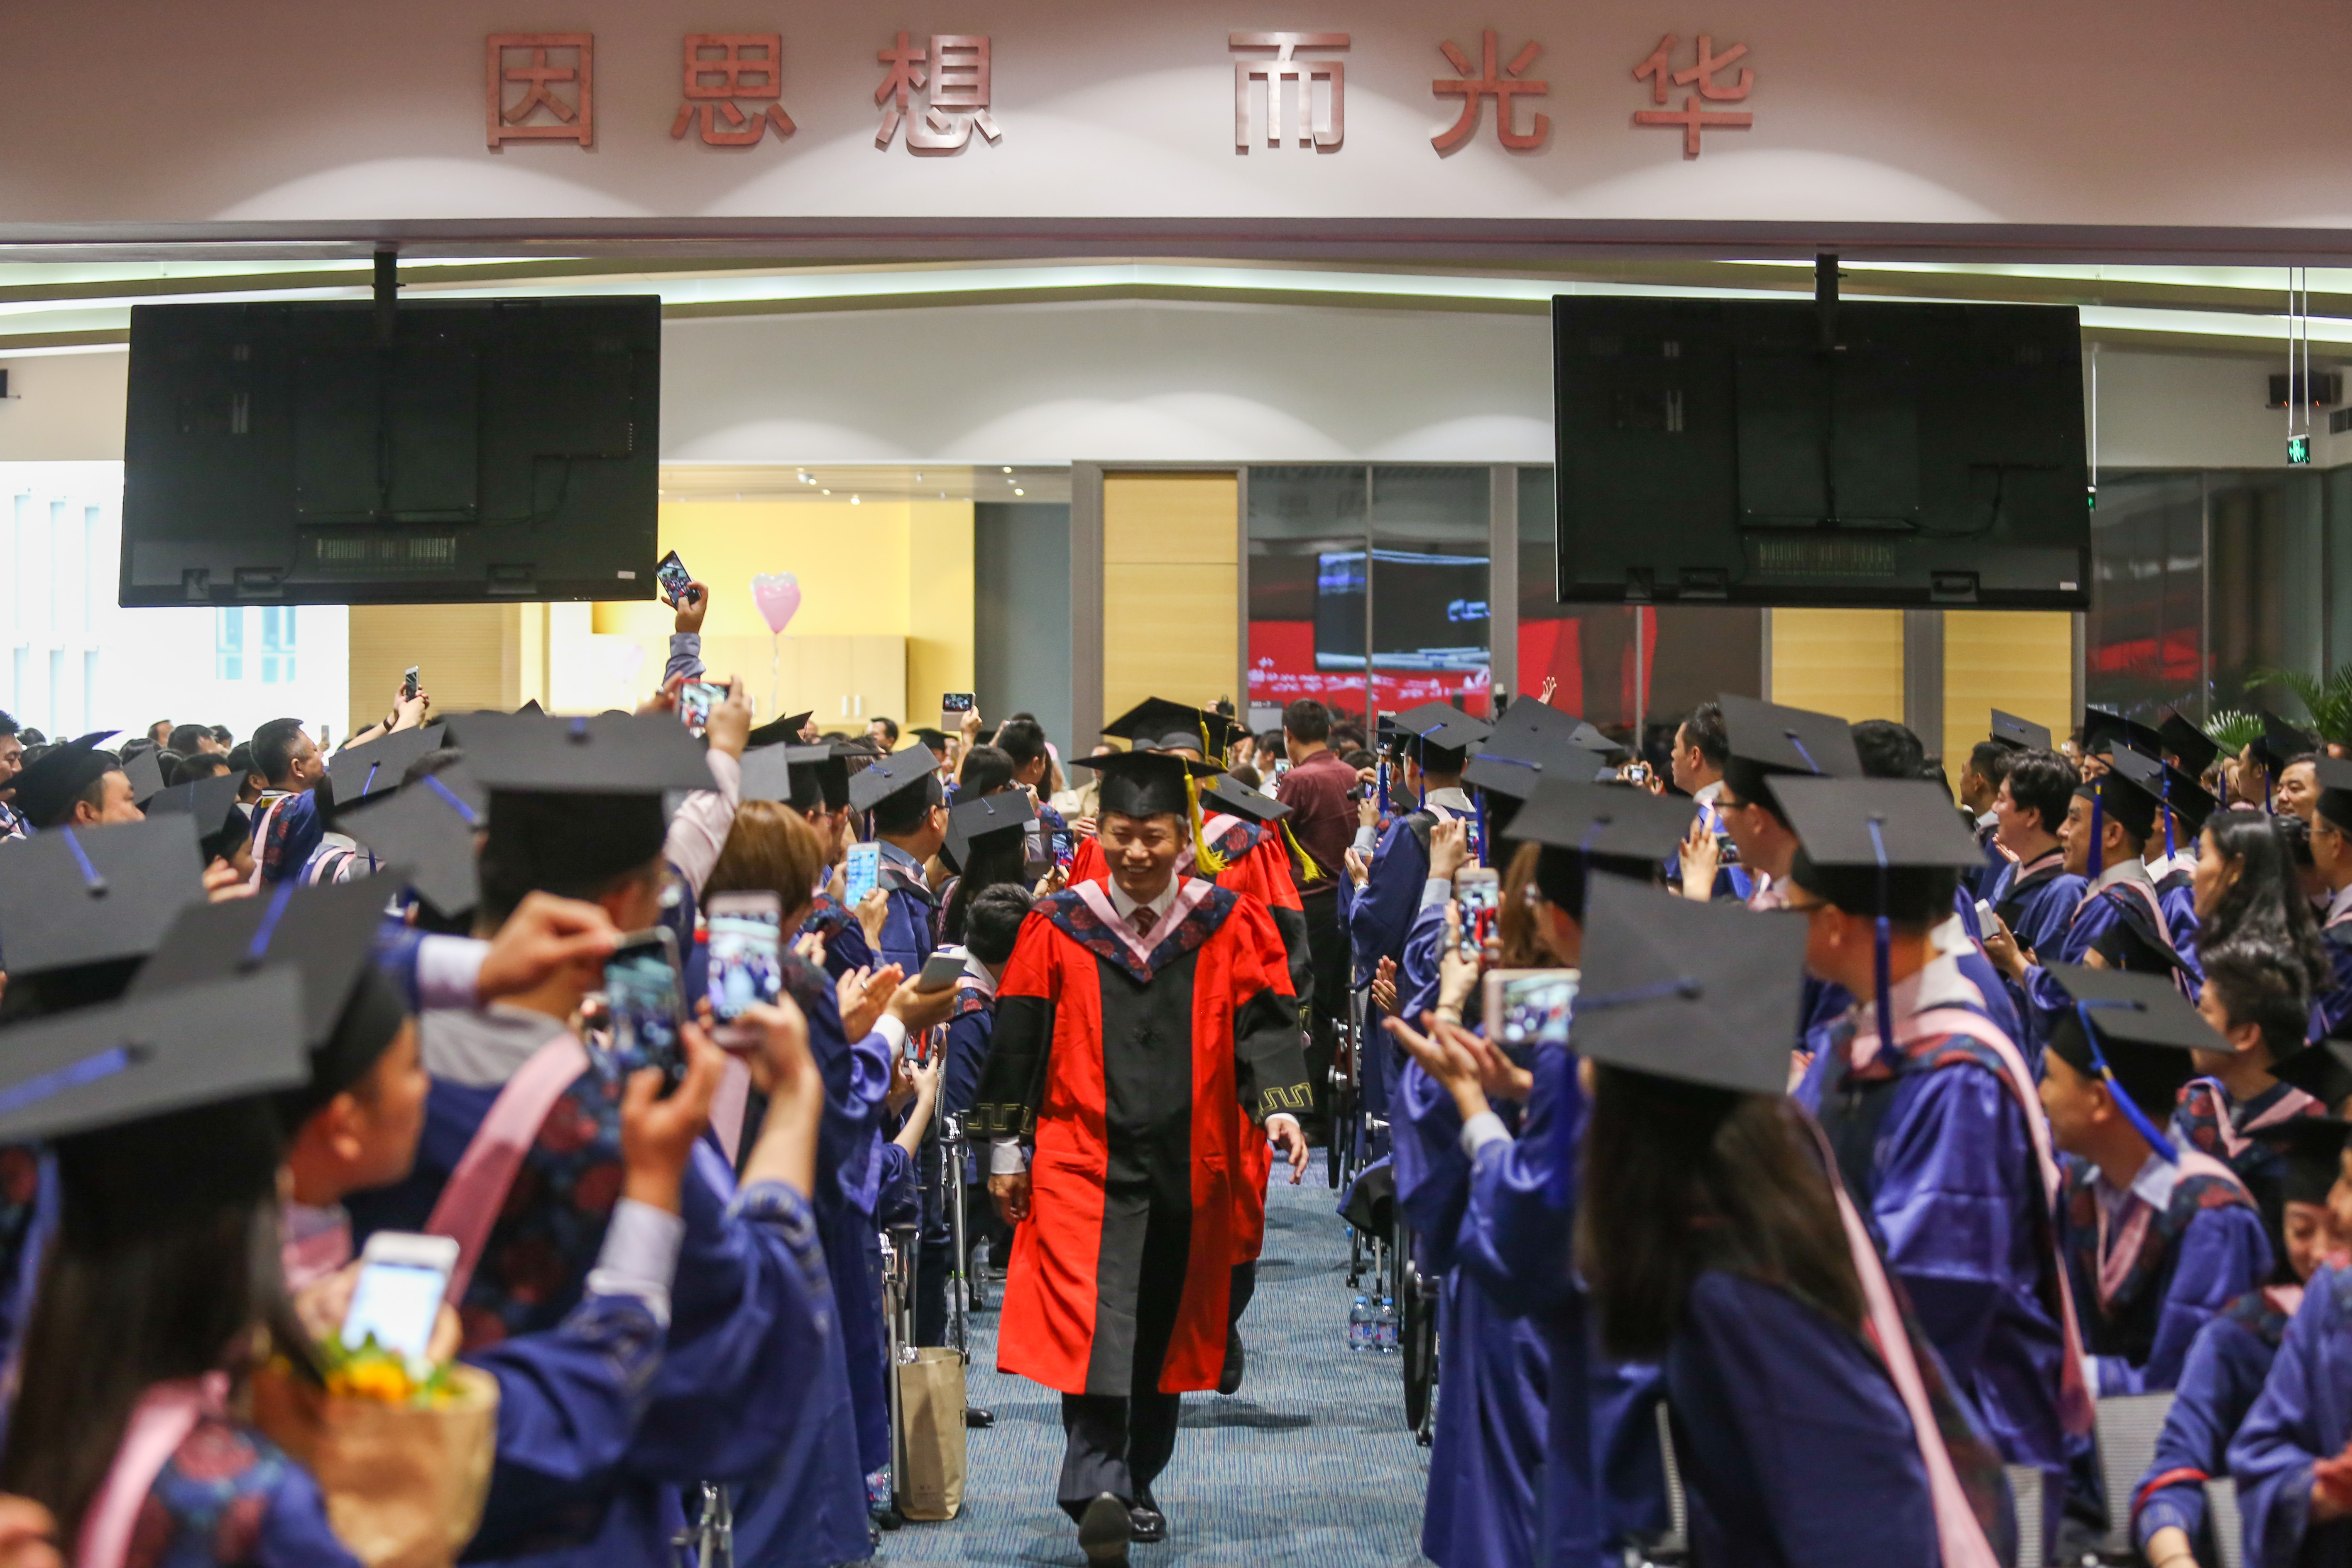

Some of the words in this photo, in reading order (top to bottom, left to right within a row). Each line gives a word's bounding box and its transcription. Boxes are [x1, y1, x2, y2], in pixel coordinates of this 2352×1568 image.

[486, 31, 1001, 156] 因思想
[1229, 30, 1754, 155] 而光华
